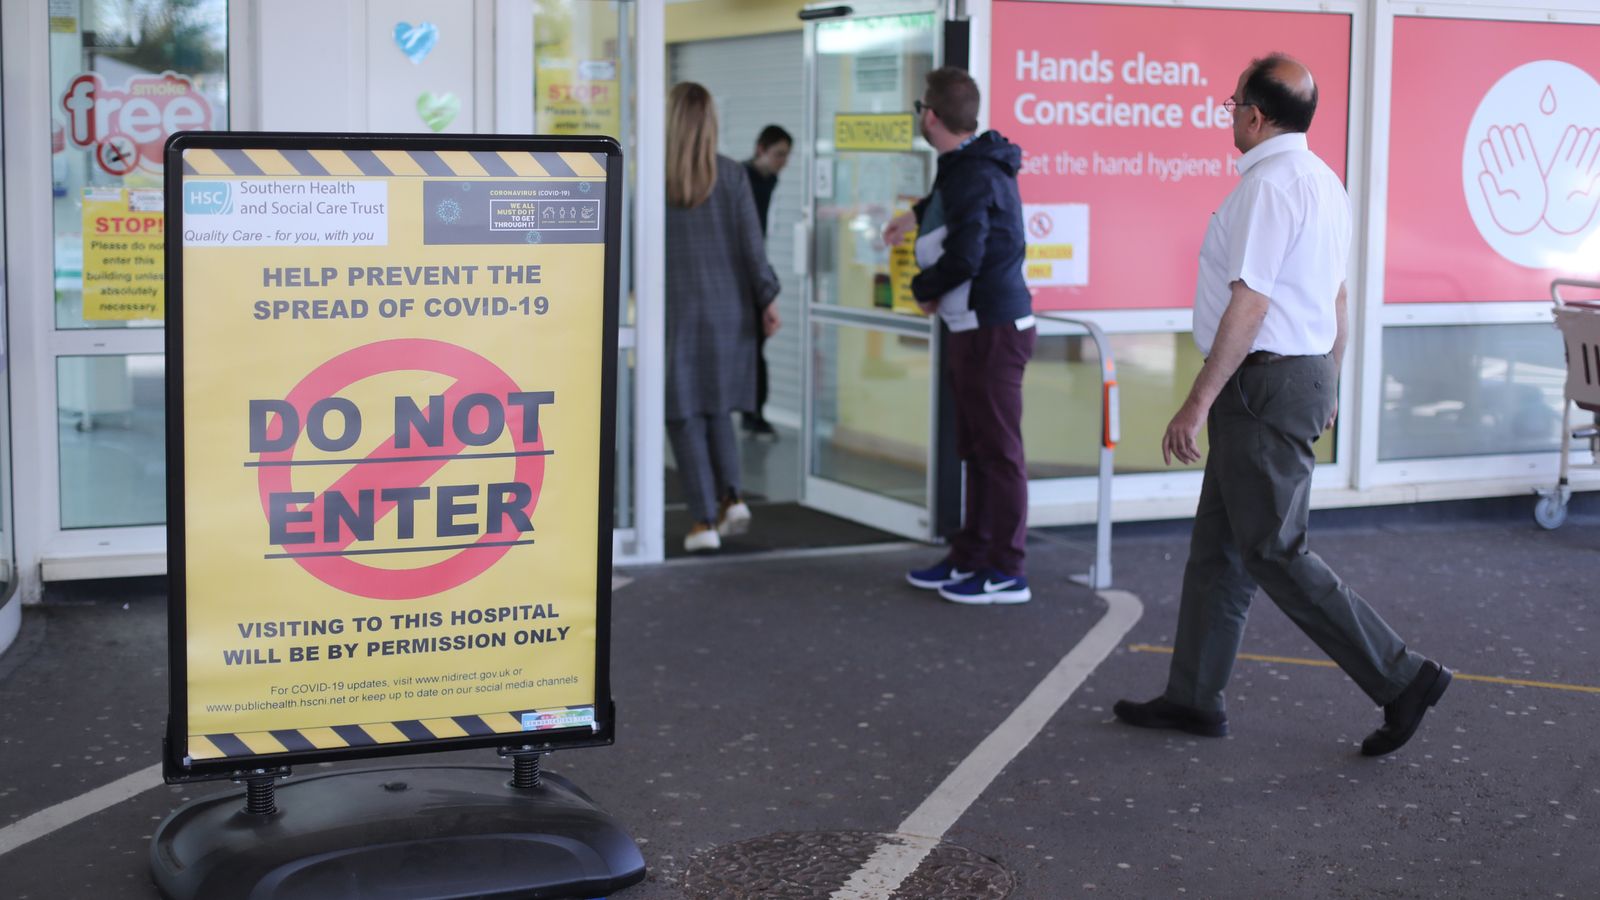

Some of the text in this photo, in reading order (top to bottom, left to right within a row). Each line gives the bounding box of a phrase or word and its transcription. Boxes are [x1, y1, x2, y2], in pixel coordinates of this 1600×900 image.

[1015, 50, 1208, 86] Hands clean.
[132, 82, 187, 96] smoke
[65, 79, 206, 144] free
[1014, 93, 1234, 129] Conscience cle
[838, 119, 910, 144] ENTRANCE
[1055, 151, 1088, 176] the
[1092, 152, 1143, 177] hand
[1148, 152, 1222, 181] hygiene
[190, 191, 223, 205] HSC
[240, 181, 355, 194] Southern Health
[240, 202, 385, 215] and Social Care Trust
[95, 217, 164, 233] STOP!
[184, 230, 228, 243] Quality
[232, 230, 262, 241] Care
[275, 230, 291, 241] for
[295, 232, 320, 243] you,
[325, 230, 349, 241] with
[352, 232, 374, 243] you
[91, 240, 128, 250] Please
[131, 240, 145, 250] do
[102, 256, 155, 265] enter this
[86, 271, 164, 282] building unles
[263, 265, 541, 287] HELP PREVENT THE
[100, 286, 158, 297] absolutely
[253, 296, 549, 320] SPREAD OF COVID-19
[249, 391, 555, 453] DO NOT
[269, 482, 535, 545] ENTER
[238, 604, 559, 639] VISITING TO THIS HOSPITAL
[223, 626, 570, 666] WILL BE BY PERMISSION ONLY
[271, 686, 288, 695] For
[291, 681, 344, 694] COVID-19
[393, 676, 412, 686] visit
[415, 668, 510, 684] www.nidirect.gov.uk
[513, 667, 523, 676] or
[206, 674, 579, 713] www.publichealth.hscni.net or keep up to date on our social media channels
